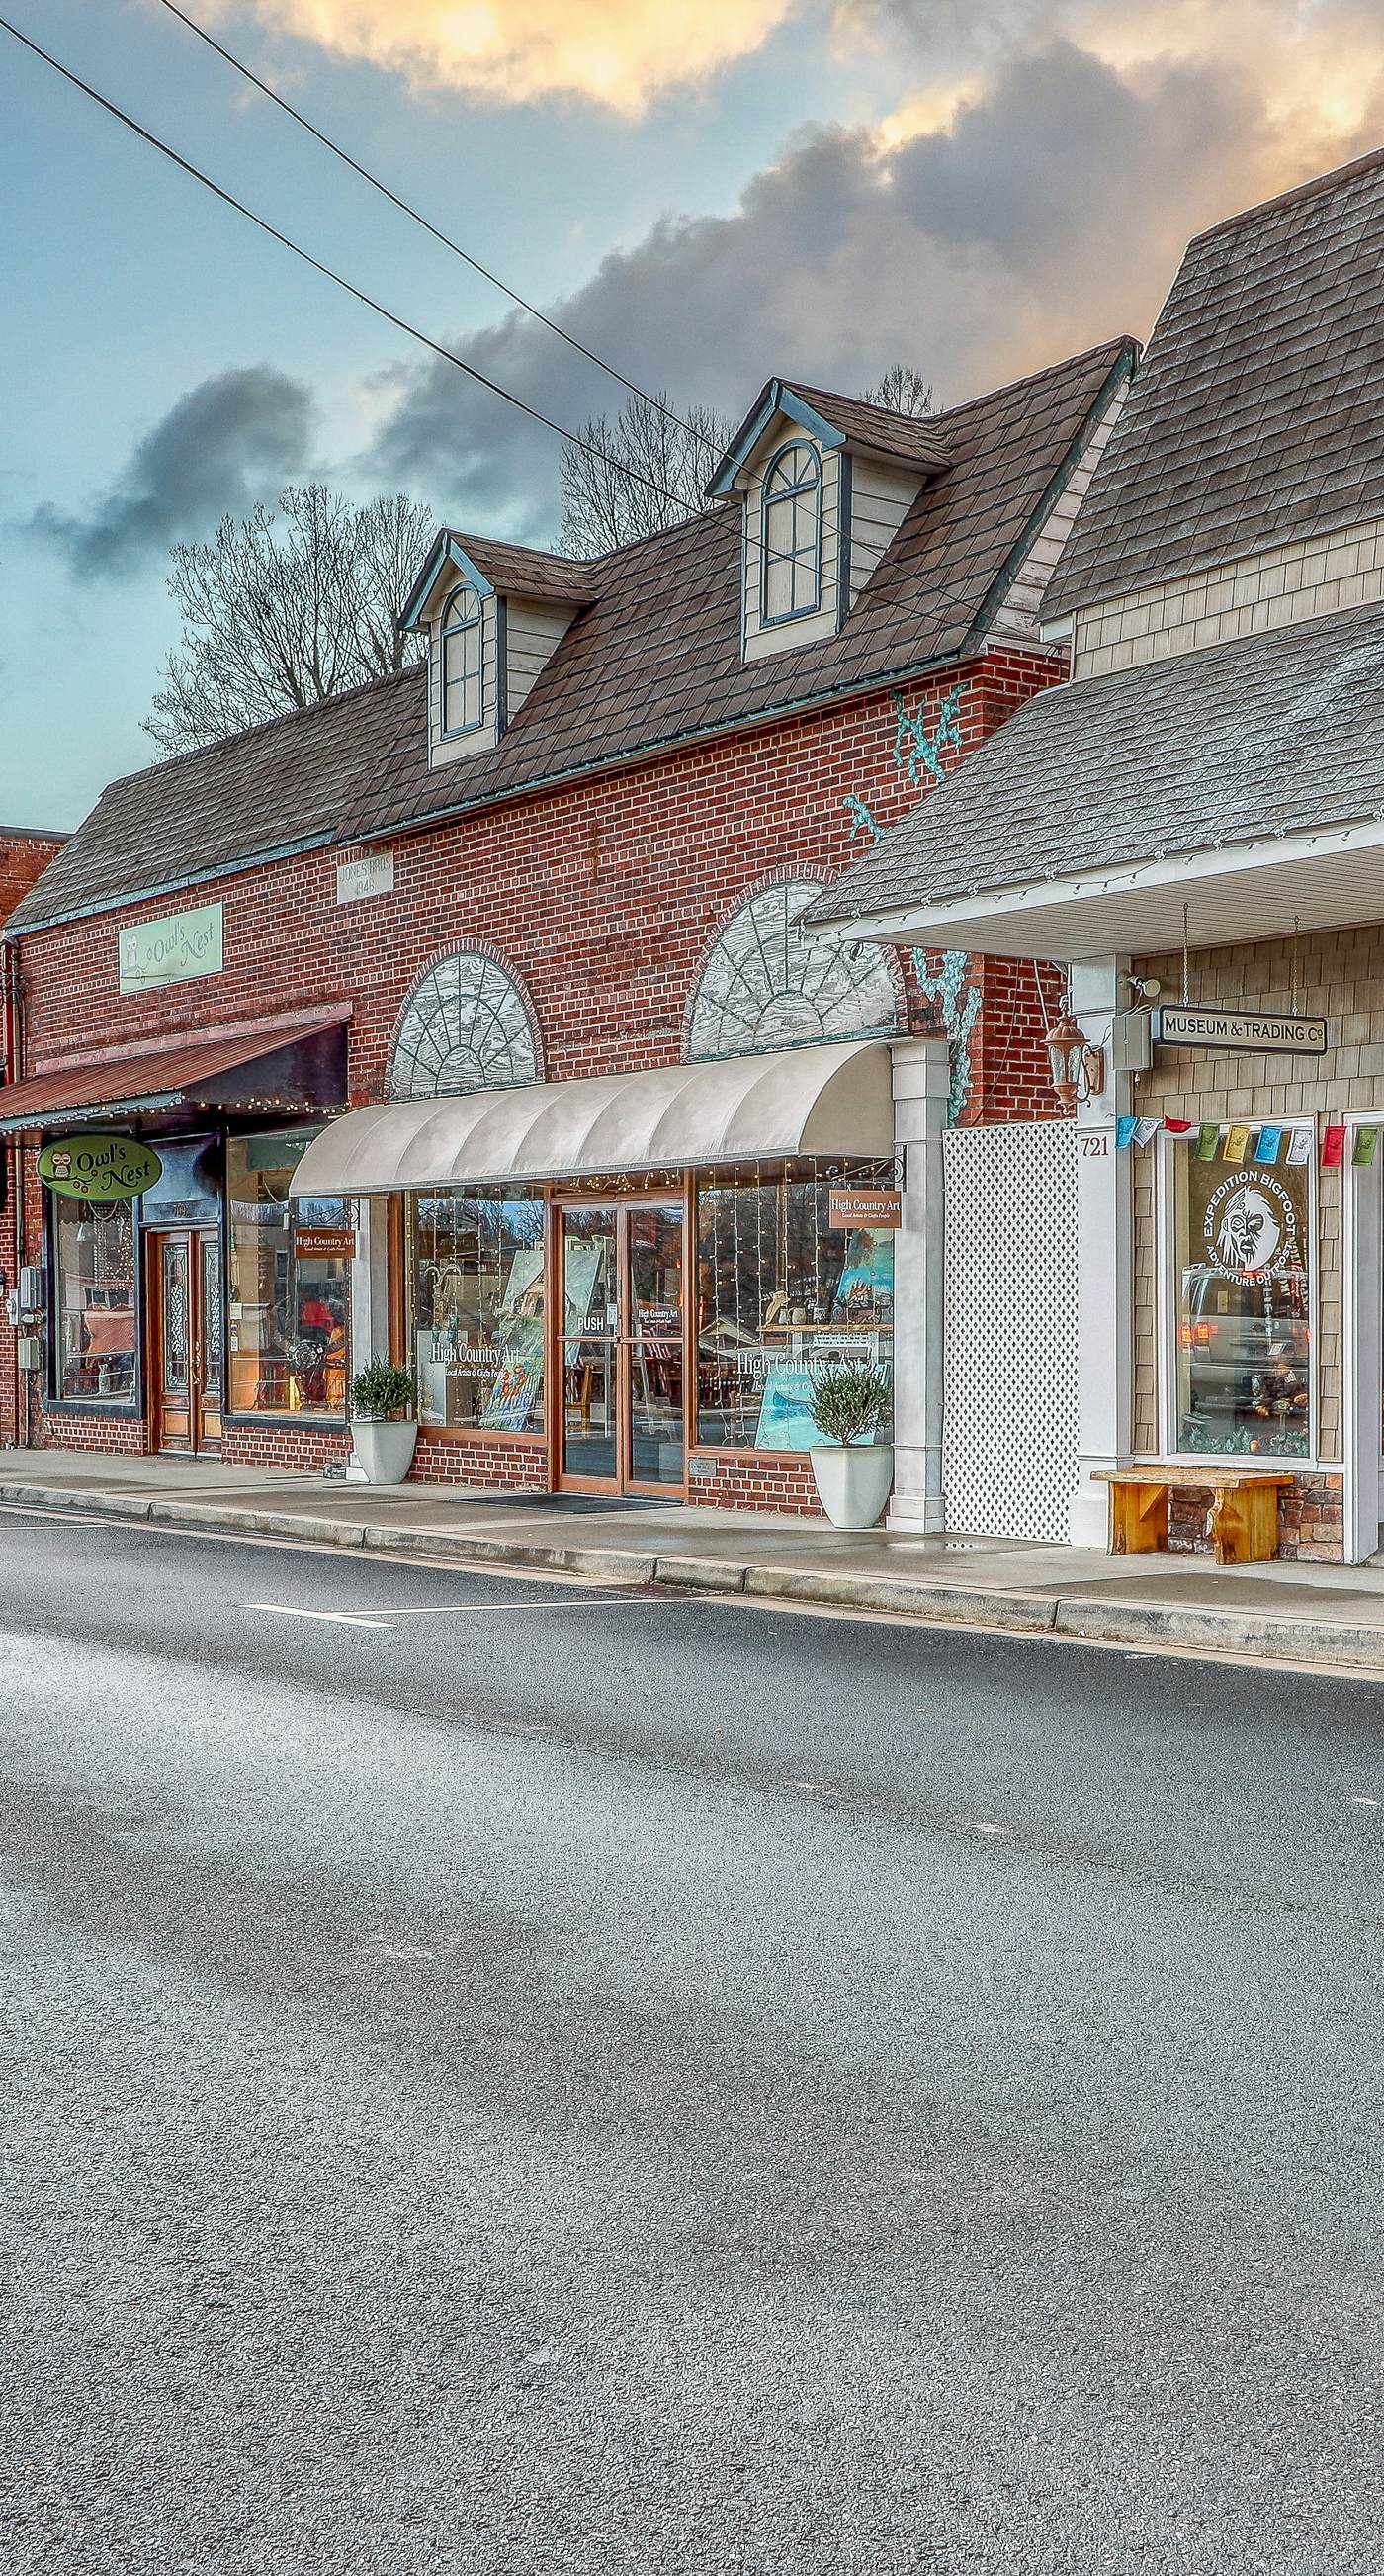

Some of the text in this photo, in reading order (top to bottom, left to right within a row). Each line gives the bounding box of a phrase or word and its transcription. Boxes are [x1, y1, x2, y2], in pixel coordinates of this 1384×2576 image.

[339, 862, 368, 882] JONES
[153, 921, 185, 962] Owl's
[180, 922, 214, 967] Nest
[1165, 1016, 1228, 1036] MUSEUM
[1230, 1022, 1243, 1037] &
[1243, 1022, 1305, 1041] TRADING
[76, 1143, 127, 1172] Owl's
[1080, 1135, 1109, 1156] 721
[101, 1161, 151, 1191] Nest
[831, 1199, 901, 1213] High Country Art
[1203, 1170, 1296, 1238] EXPEDITION BIGFOOT
[296, 1236, 355, 1247] High Country Art
[1206, 1246, 1256, 1287] ADVENTURE
[1256, 1241, 1292, 1283] OUTPOST
[577, 1316, 604, 1331] PUSH
[638, 1309, 649, 1318] High
[649, 1309, 670, 1318] Country
[431, 1342, 520, 1368] High Country Art
[736, 1351, 771, 1379] High
